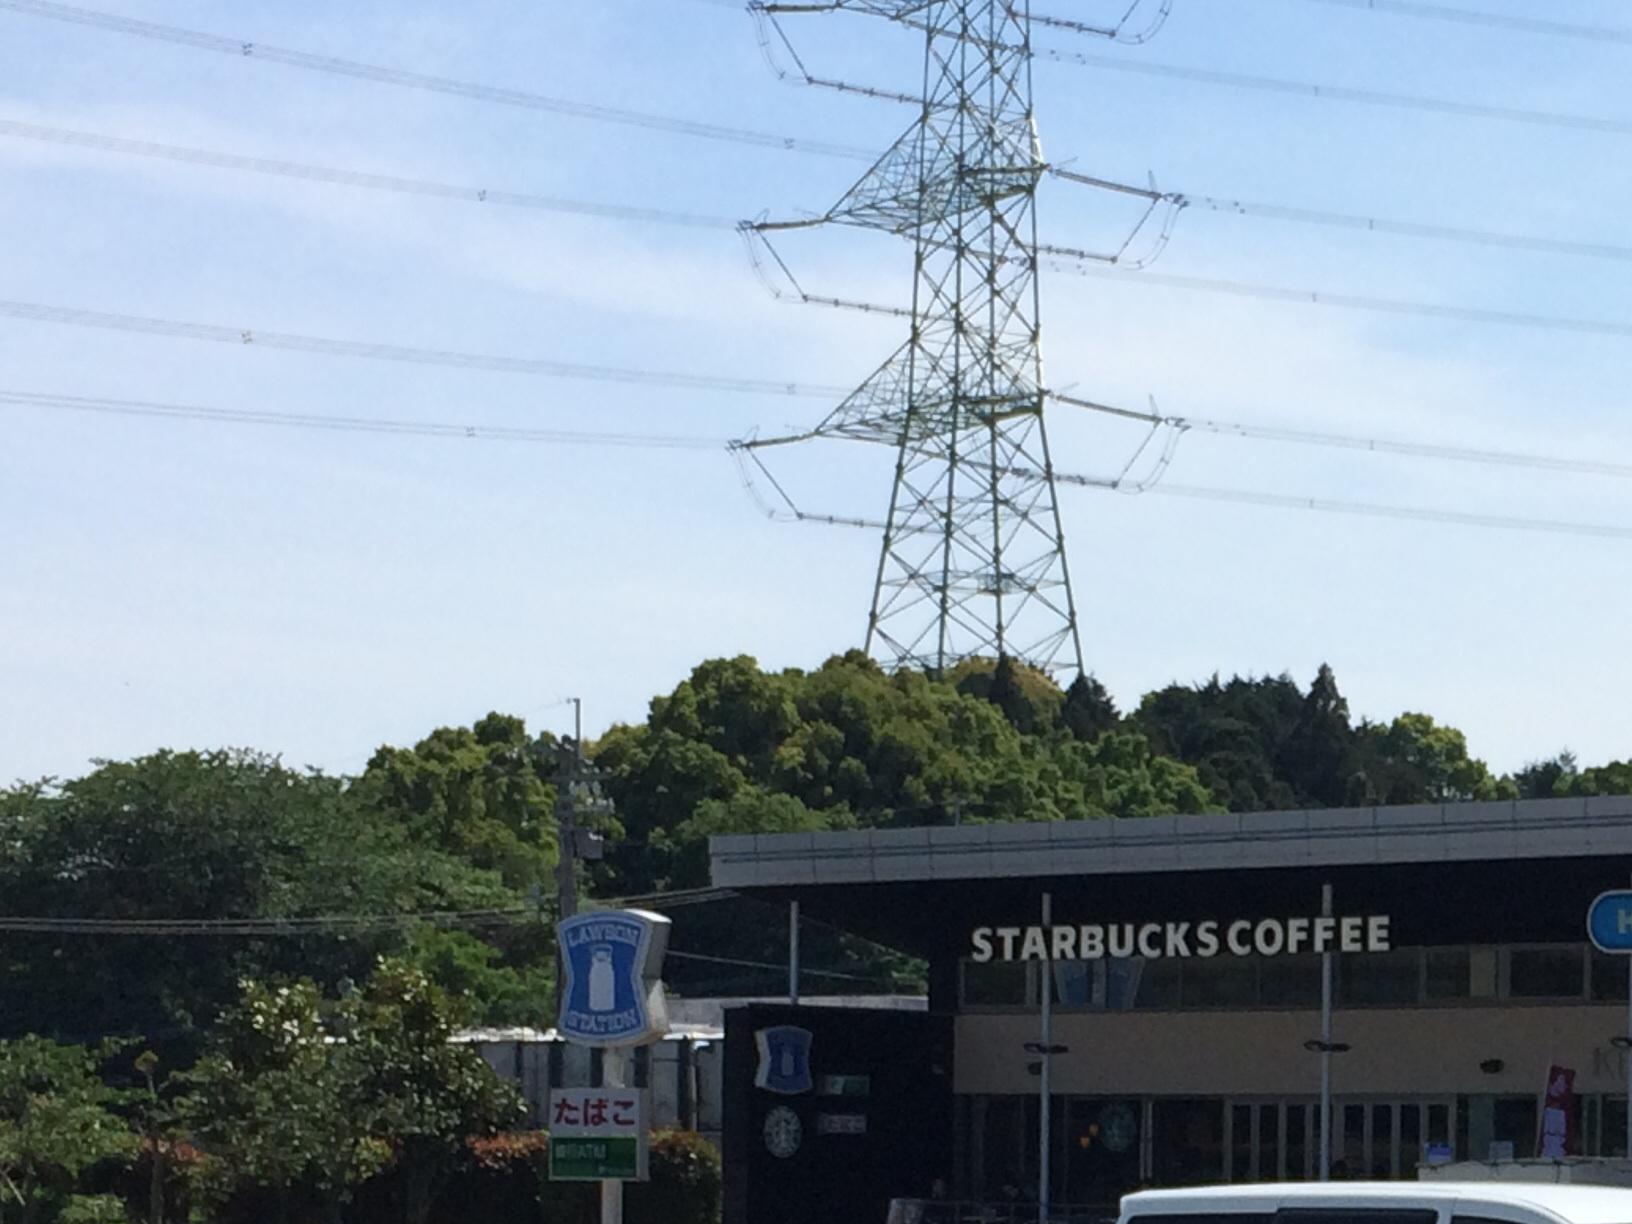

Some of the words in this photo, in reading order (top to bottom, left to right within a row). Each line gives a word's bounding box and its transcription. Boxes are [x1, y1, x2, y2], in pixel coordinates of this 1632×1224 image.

[567, 924, 640, 947] LAWSON
[971, 920, 1219, 963] STARBUCKS
[1227, 914, 1391, 958] COFFEE
[567, 1008, 639, 1033] STATION
[554, 1098, 635, 1127] たばこ
